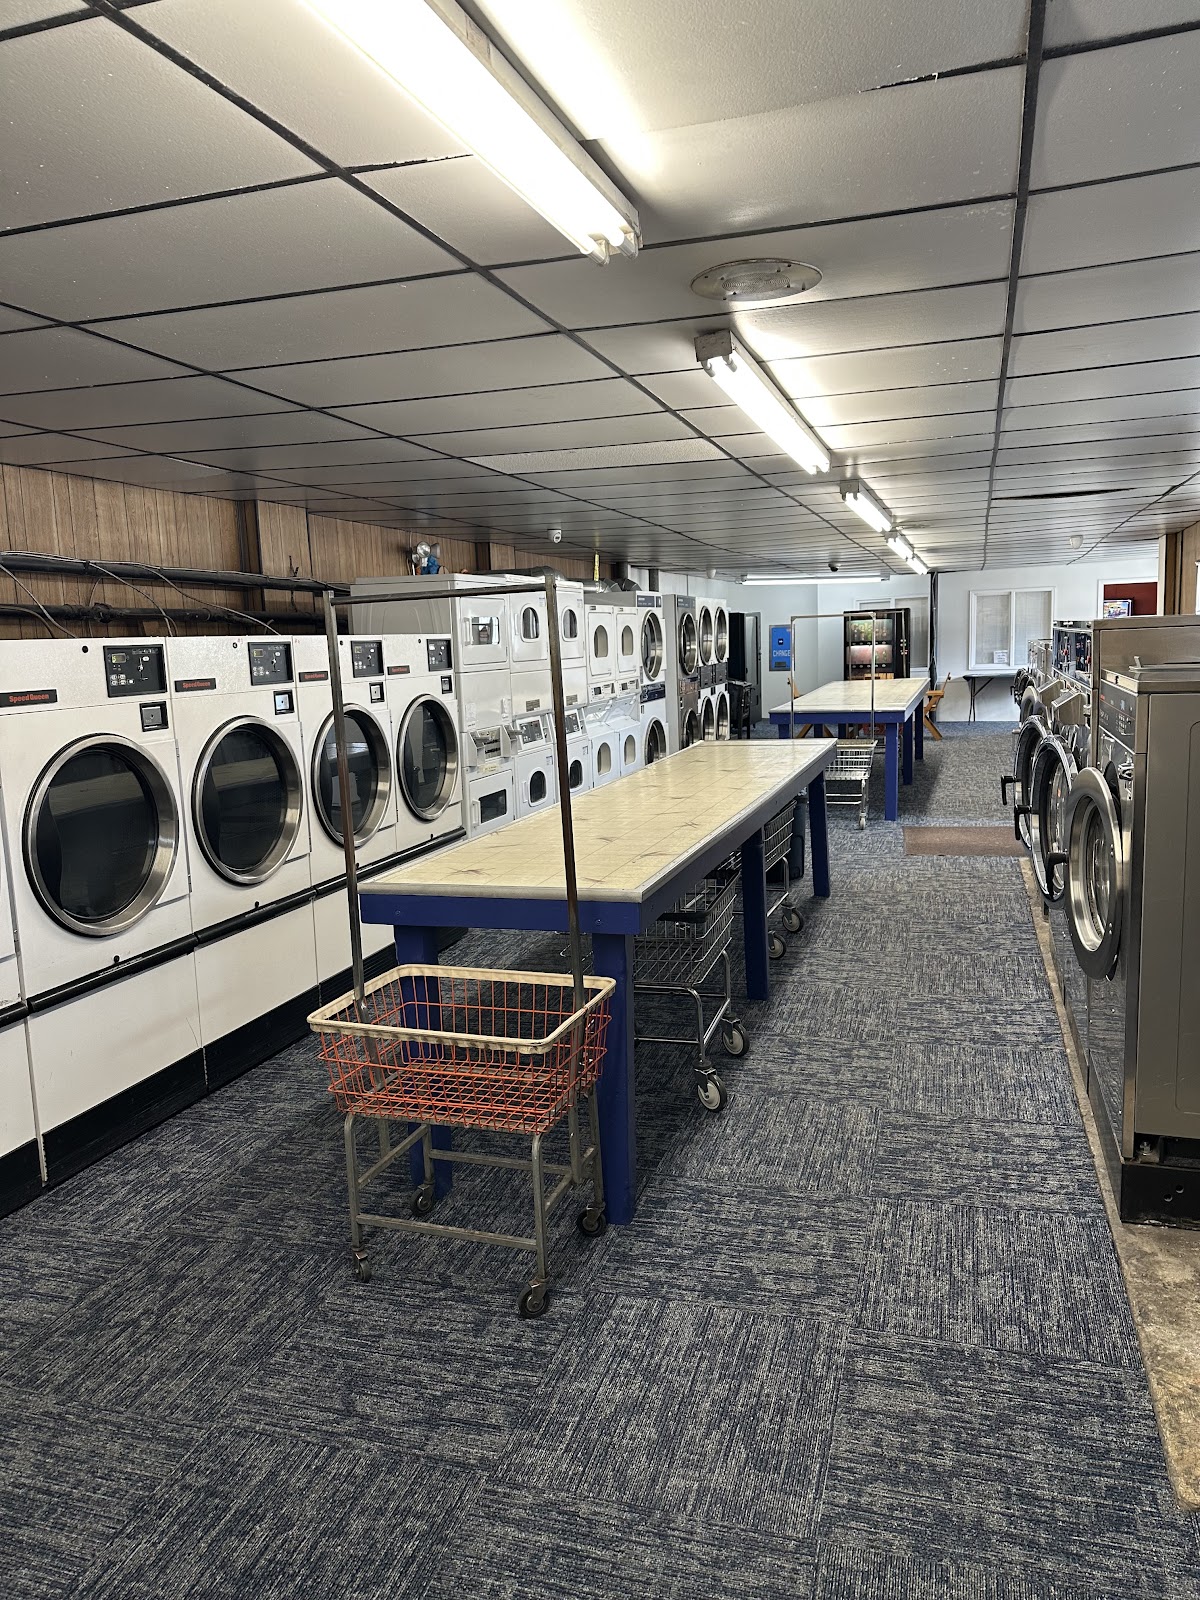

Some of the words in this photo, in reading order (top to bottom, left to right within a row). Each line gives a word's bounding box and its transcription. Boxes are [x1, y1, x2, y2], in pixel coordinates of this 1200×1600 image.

[773, 649, 791, 657] CHANGE
[9, 694, 30, 704] Speed
[29, 693, 50, 701] Queen
